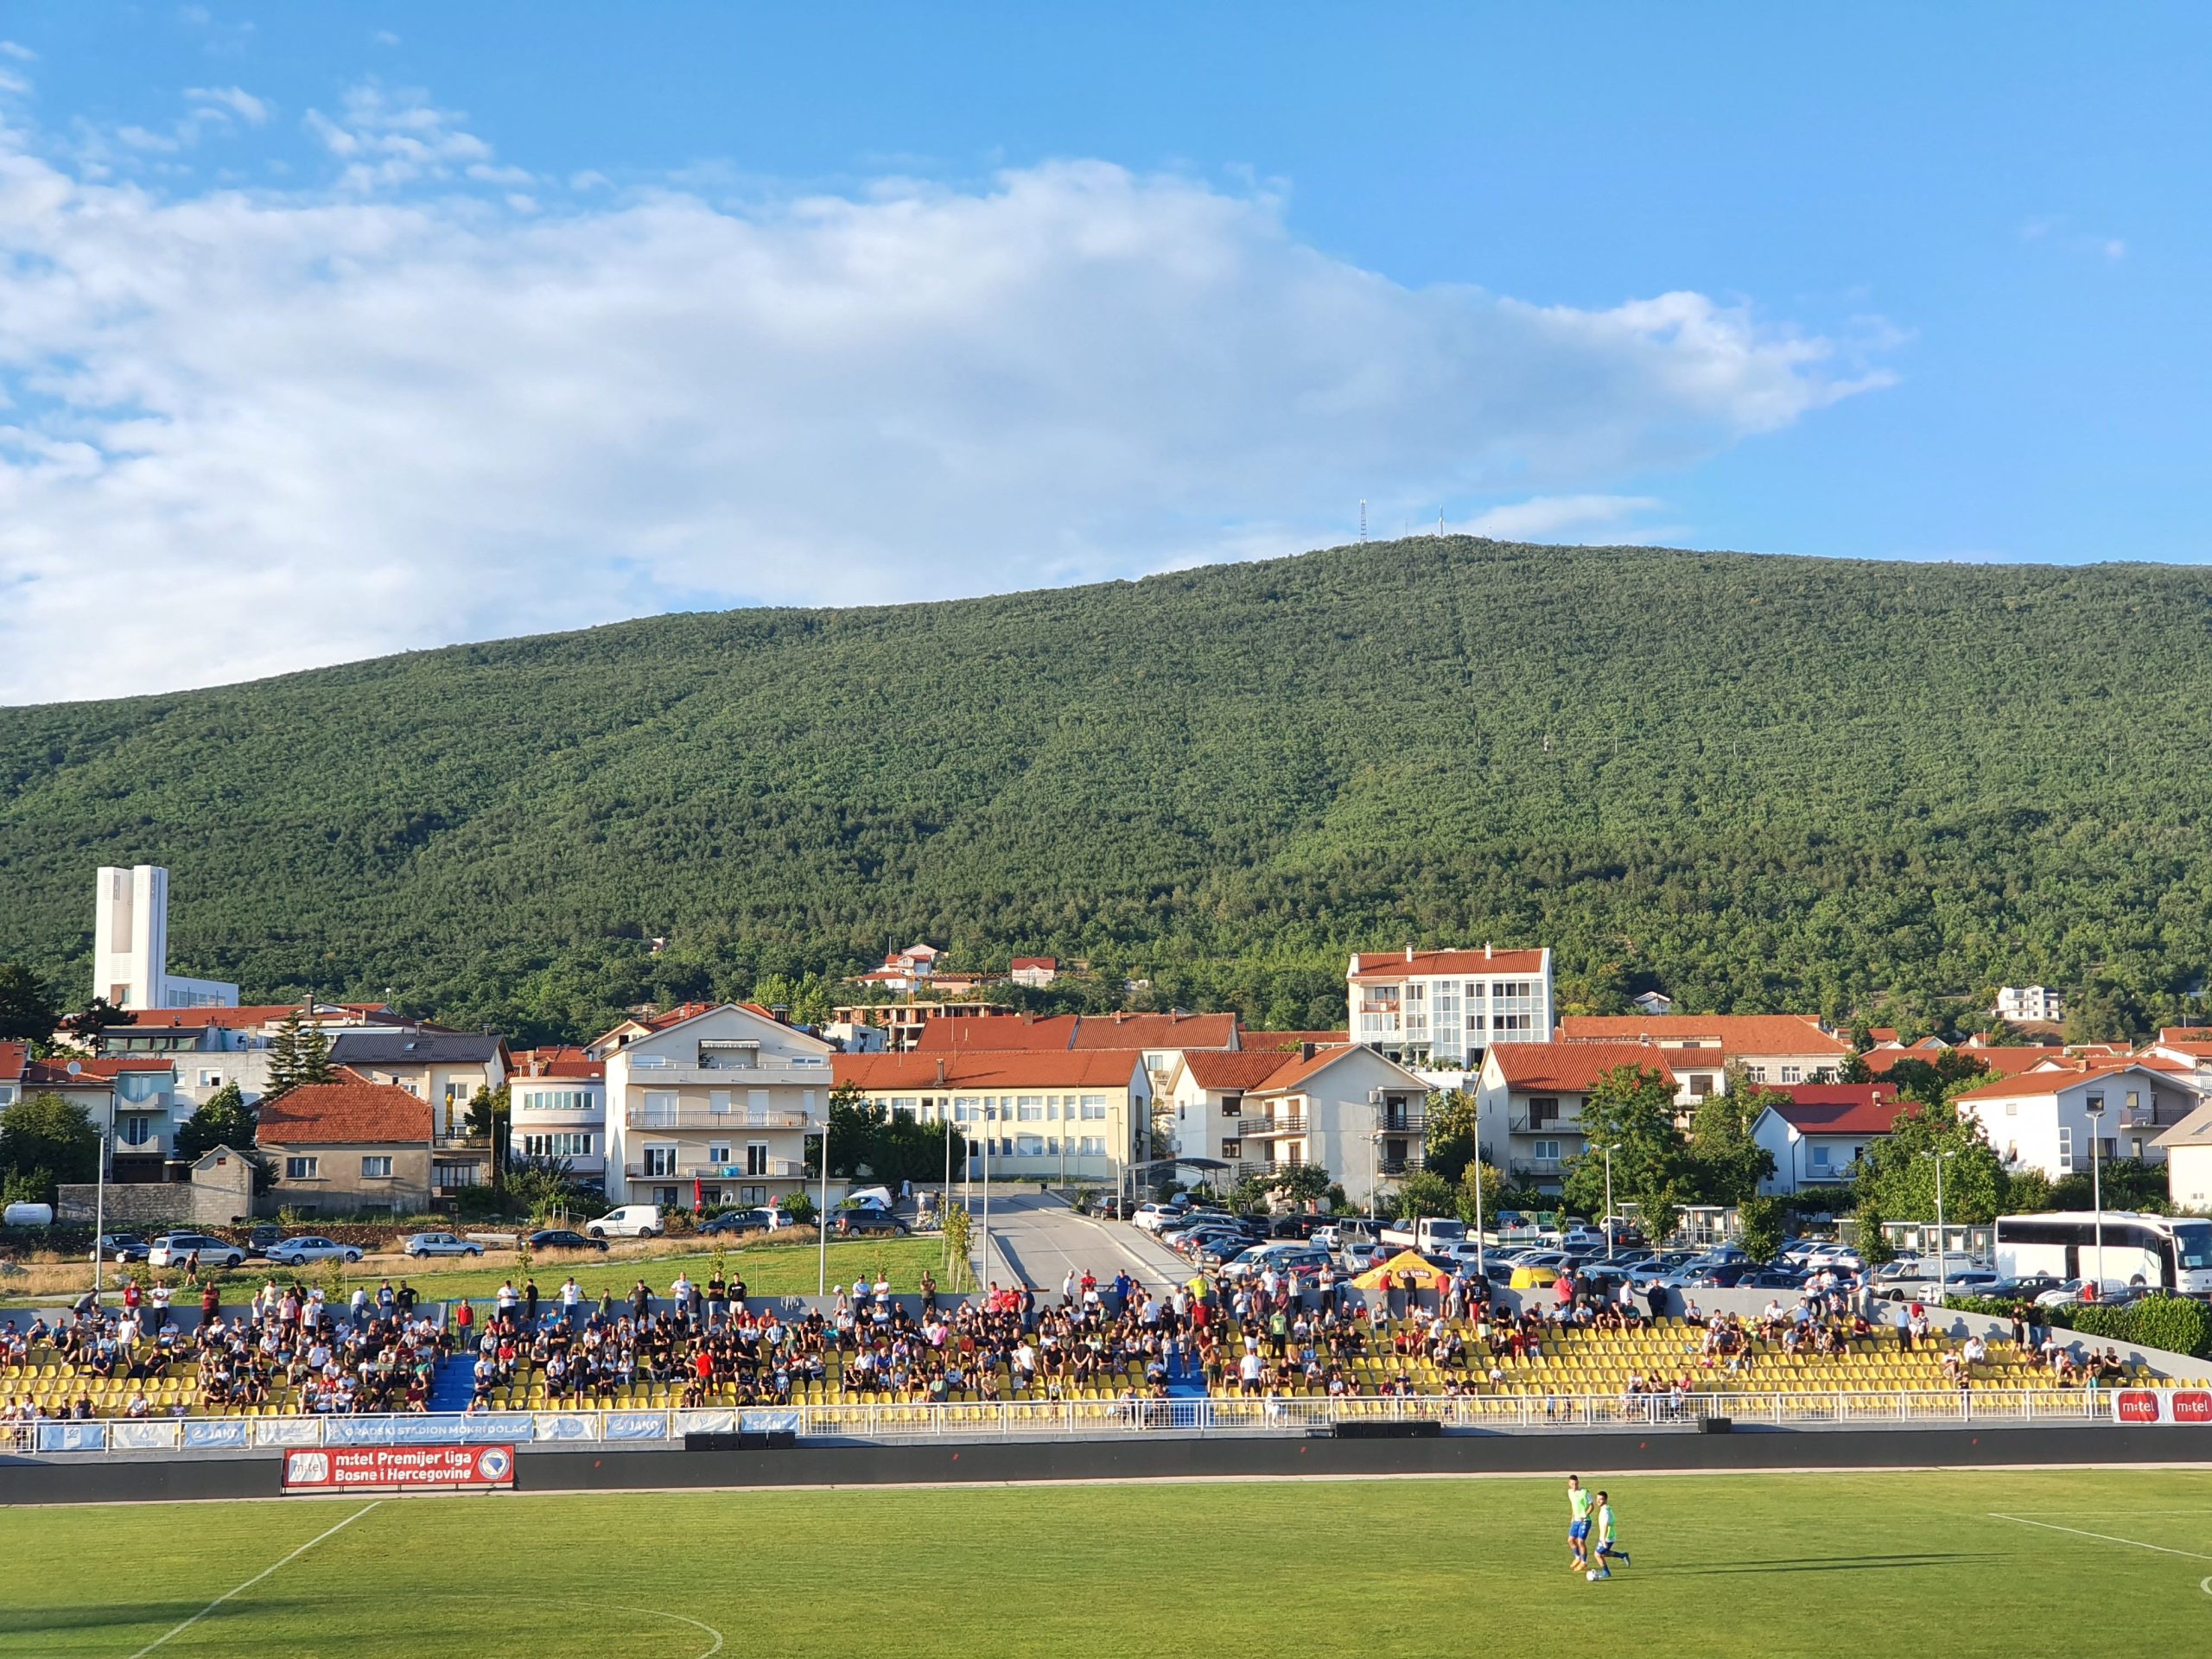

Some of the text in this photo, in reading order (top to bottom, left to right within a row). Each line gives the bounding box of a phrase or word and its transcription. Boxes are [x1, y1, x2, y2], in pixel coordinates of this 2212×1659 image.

[2122, 1400, 2154, 1412] m:tel
[2177, 1399, 2209, 1412] m:tel
[345, 1425, 527, 1437] GRADSKI STADION MOKRI DOLAC
[335, 1451, 472, 1467] m:tel Premijer liga
[294, 1461, 322, 1473] m:tel
[334, 1467, 472, 1483] Bosne i Hercegovine
